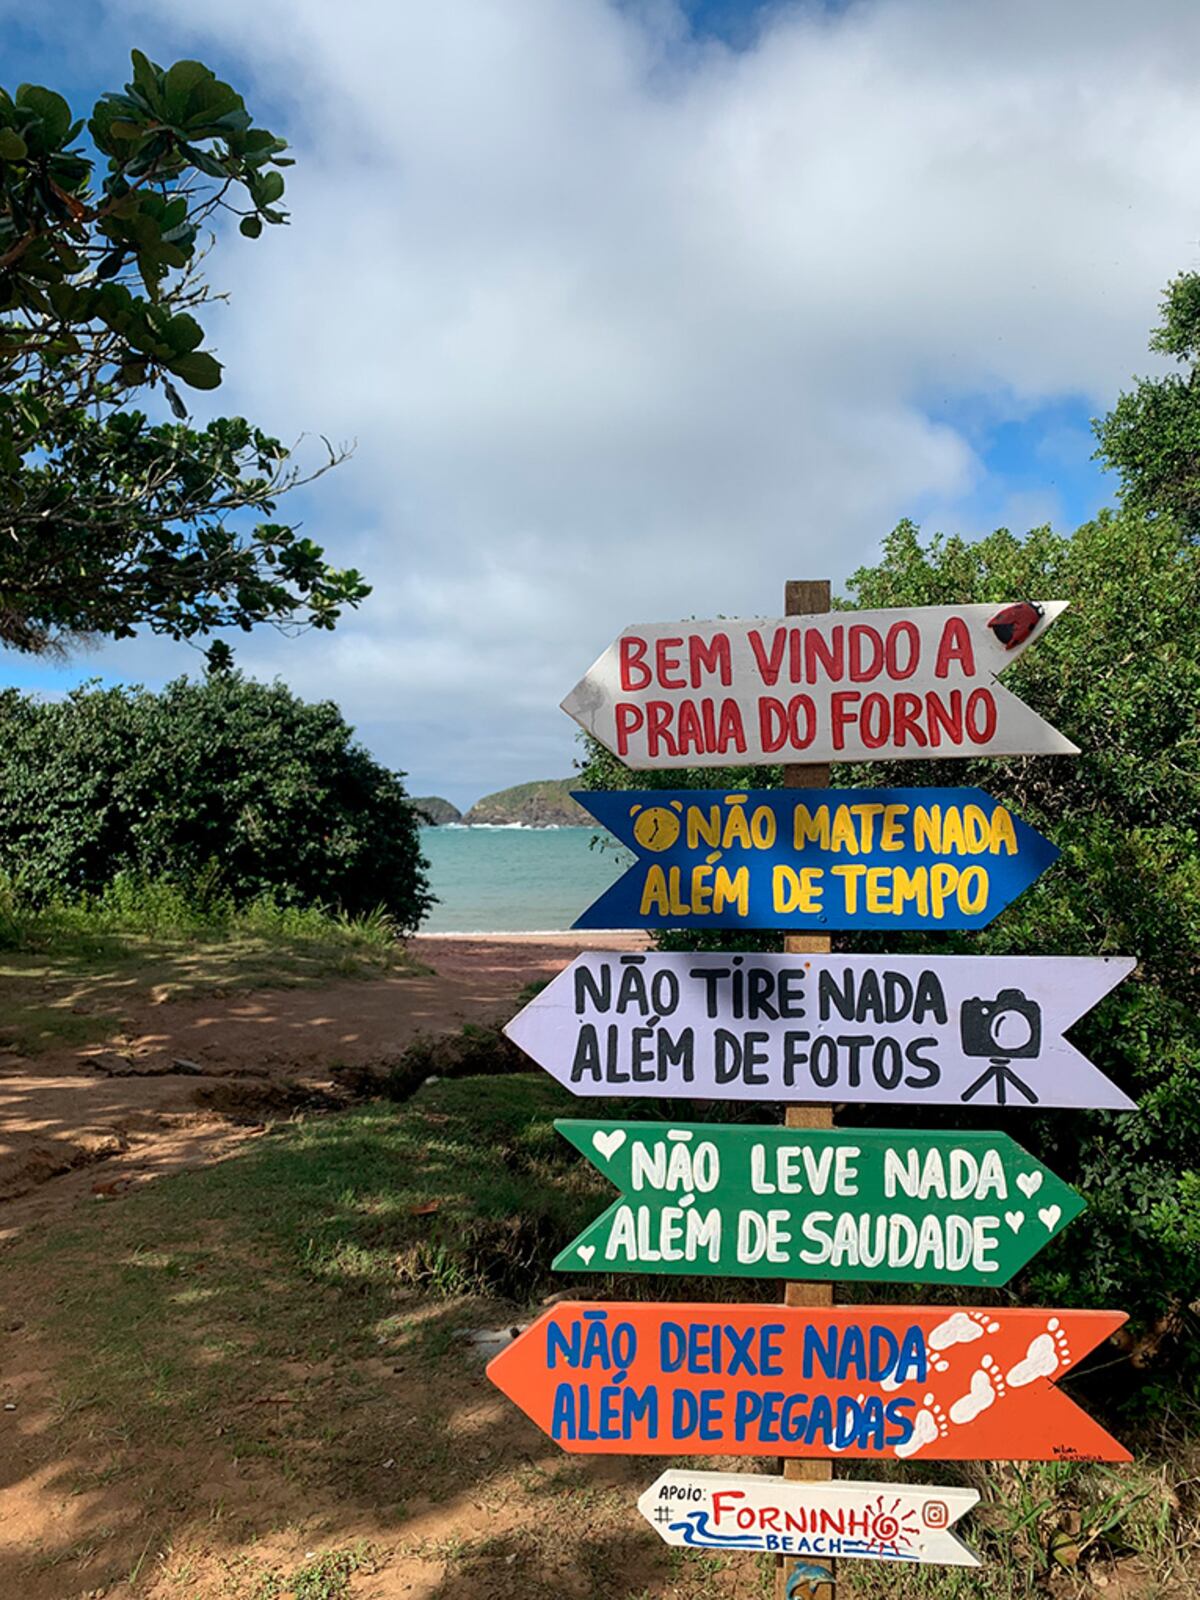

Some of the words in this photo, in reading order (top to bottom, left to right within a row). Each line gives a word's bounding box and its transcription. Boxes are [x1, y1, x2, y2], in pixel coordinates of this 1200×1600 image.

[619, 632, 732, 691] BEM
[747, 620, 920, 685] VINDO
[934, 616, 976, 679] A
[615, 698, 747, 757] PRAIA
[759, 694, 817, 753] DO
[831, 687, 997, 750] FORNO
[687, 794, 777, 850] NÃO
[793, 803, 906, 855] MATE
[914, 804, 1018, 855] NADA
[639, 852, 749, 916] ALÉM
[773, 865, 824, 913] DE
[830, 863, 989, 919] TEMPO
[574, 955, 679, 1017] NÃO
[819, 968, 948, 1025] NADA
[571, 1017, 694, 1083] ALÉM
[714, 1031, 770, 1085] DE
[783, 1033, 940, 1090] FOTOS
[631, 1129, 720, 1194] NÃO
[751, 1145, 859, 1195] LEVE
[885, 1148, 1008, 1200] NADA
[605, 1193, 721, 1263] ALÉM
[736, 1209, 792, 1262] DE
[800, 1210, 999, 1272] SAUDADE
[547, 1311, 636, 1371] NÃO
[660, 1323, 784, 1377] DEIXE
[802, 1325, 927, 1384] NADA
[552, 1370, 658, 1441] ALÉM
[672, 1390, 723, 1440] DE
[735, 1391, 915, 1450] PEGADAS
[767, 1535, 842, 1554] BEACH
